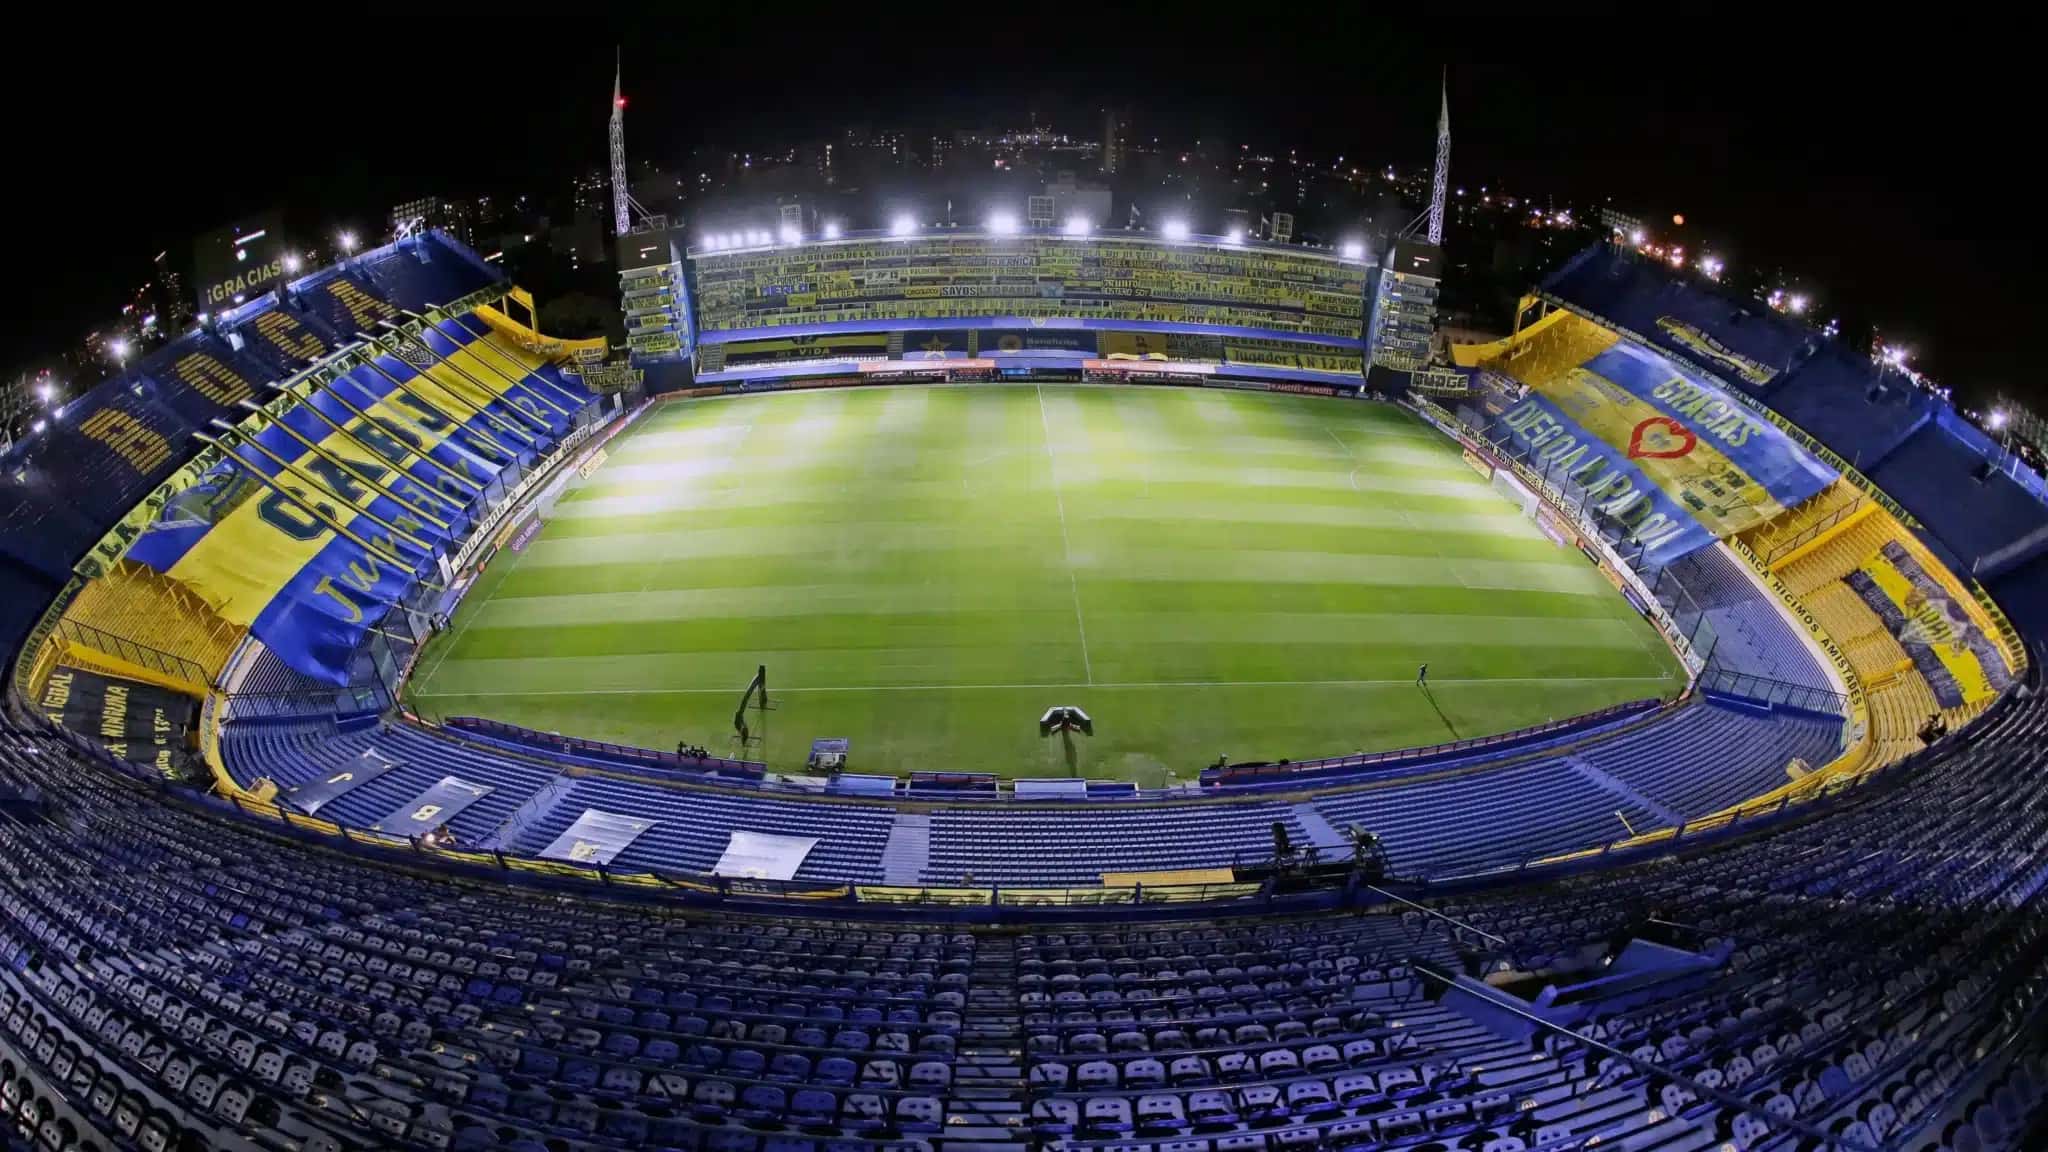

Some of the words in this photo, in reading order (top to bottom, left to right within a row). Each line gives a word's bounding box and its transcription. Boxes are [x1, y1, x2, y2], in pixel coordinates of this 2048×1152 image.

[78, 280, 399, 476] BOCA
[1652, 377, 1764, 447] GRACIAS
[1735, 539, 1770, 580] NUNCA
[1772, 581, 1820, 634] HICIMOS
